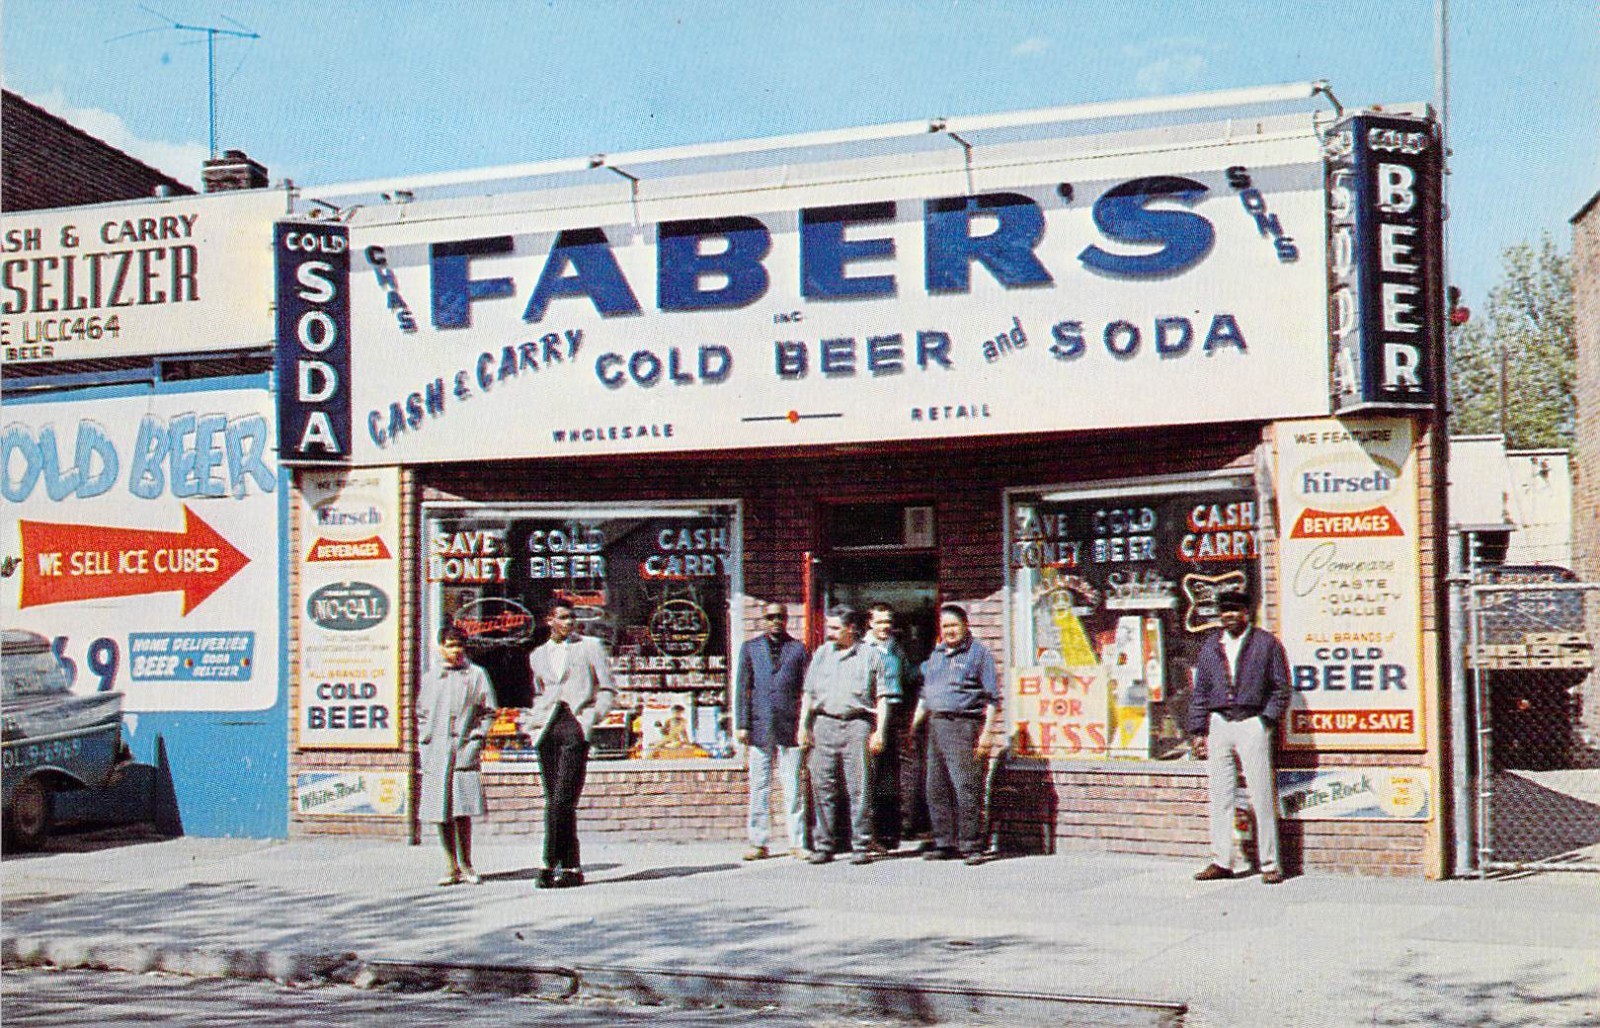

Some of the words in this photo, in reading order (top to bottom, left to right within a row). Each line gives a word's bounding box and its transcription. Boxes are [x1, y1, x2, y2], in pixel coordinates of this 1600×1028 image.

[1226, 165, 1300, 263] SONS
[60, 225, 80, 249] &
[100, 213, 199, 246] CARRY
[286, 231, 346, 253] COLD
[429, 174, 1216, 332] FABER'S
[1, 244, 201, 315] SELTZER
[364, 245, 418, 334] CHAS
[1378, 163, 1424, 394] BEER
[773, 311, 803, 324] INC
[6, 345, 55, 360] BEER
[296, 260, 343, 453] SODA
[595, 345, 734, 389] COLD
[774, 330, 955, 380] BEER
[981, 315, 1029, 363] and
[1049, 314, 1250, 361] SODA
[367, 378, 446, 449] CASH
[453, 370, 472, 400] &
[476, 328, 585, 392] CARRY
[911, 403, 992, 421] RETAIL
[552, 424, 675, 443] WHOLESALE
[1295, 430, 1317, 444] WE
[1322, 429, 1392, 443] FEATURE
[1, 418, 119, 502] OLD
[129, 412, 277, 500] BEER
[1191, 501, 1256, 528] CASH
[1303, 515, 1390, 533] BEVERAGES
[431, 530, 495, 554] SAVE
[528, 530, 605, 552] COLD
[658, 528, 726, 550] CASH
[1093, 536, 1156, 563] BEER
[38, 552, 63, 576] WE
[70, 550, 112, 576] SELL
[118, 550, 150, 574] ICE
[153, 548, 220, 573] CUBES
[530, 555, 606, 578] BEER
[313, 597, 382, 621] NO-CAL
[1305, 633, 1329, 643] ALL
[1334, 632, 1383, 643] BRANDS
[132, 654, 180, 677] BEER
[1315, 647, 1384, 660] COLD
[1018, 676, 1097, 696] BUY
[1292, 663, 1407, 691] BEER
[316, 682, 378, 700] COLD
[308, 704, 390, 730] BEER
[1038, 699, 1083, 716] FOR
[1367, 713, 1411, 730] SAVE
[1016, 720, 1108, 756] LESS
[333, 775, 366, 798] Rock
[1327, 773, 1373, 801] Rock
